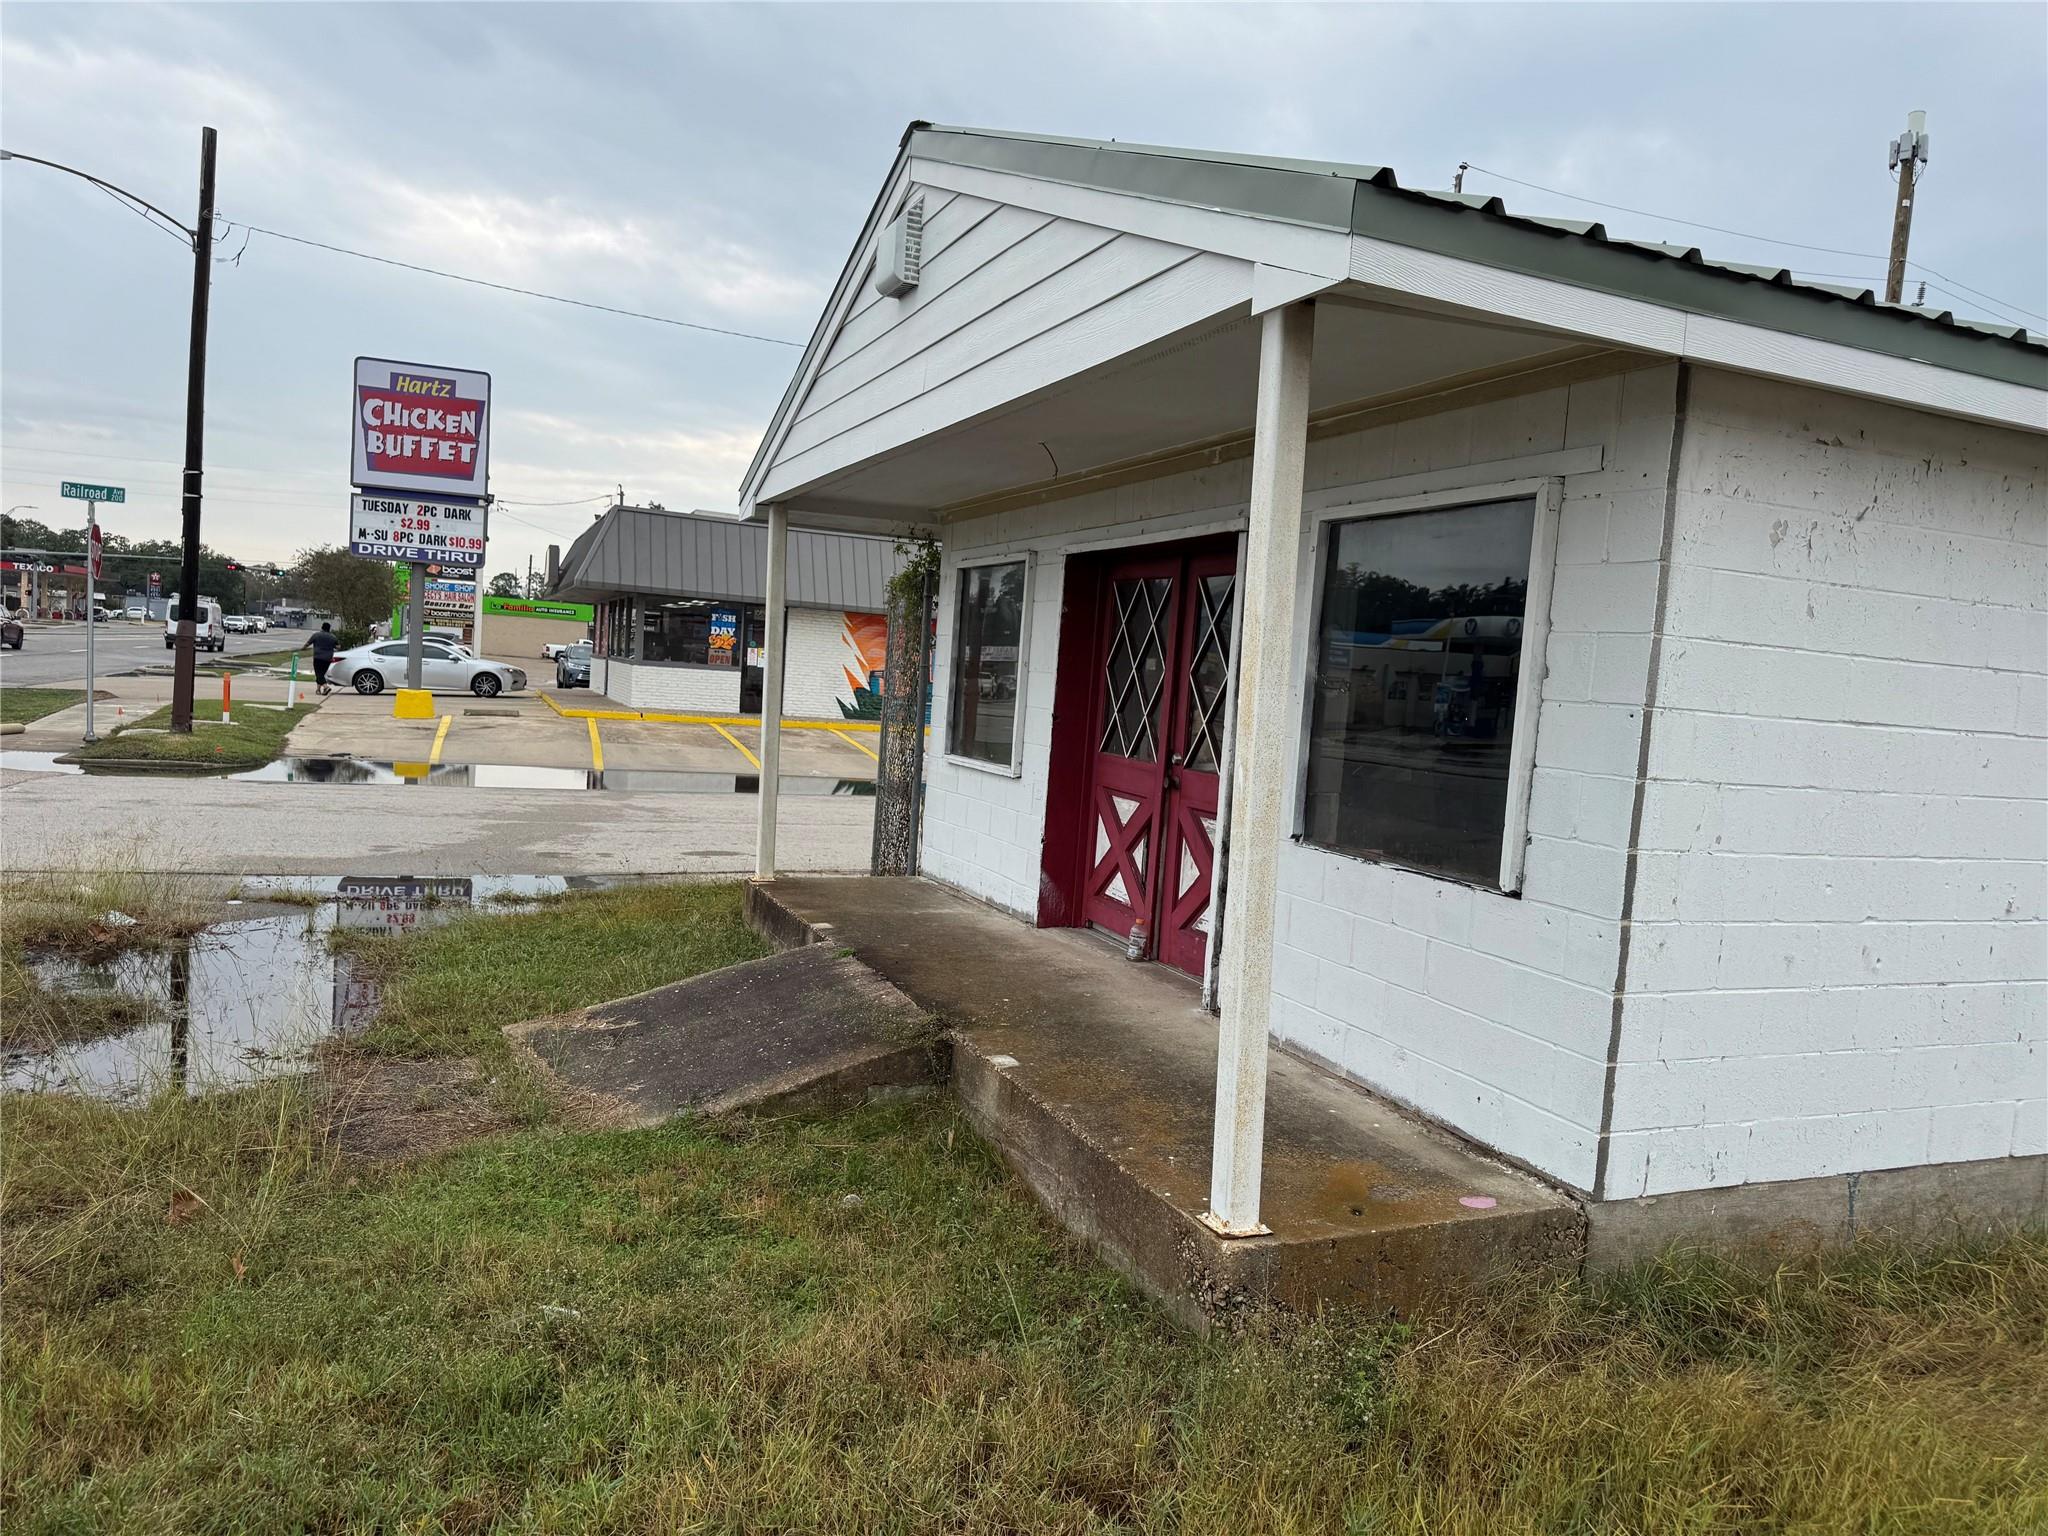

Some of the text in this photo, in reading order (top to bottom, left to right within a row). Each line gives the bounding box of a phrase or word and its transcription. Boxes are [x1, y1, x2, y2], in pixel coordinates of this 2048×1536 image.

[397, 376, 451, 398] Hartz
[362, 398, 476, 437] CHICKEN
[367, 430, 477, 464] BUFFET
[63, 484, 107, 500] Railroad
[111, 494, 123, 502] 200
[362, 499, 472, 521] TUESDAY 2PC DARK
[400, 518, 430, 531] $2.99
[393, 531, 414, 543] 8PC
[419, 533, 447, 547] DARK
[449, 536, 482, 550] $10.99
[358, 543, 478, 564] DRIVE THRU
[442, 565, 474, 576] boost
[424, 583, 474, 592] SMOKE SHOP
[710, 626, 736, 636] DAY
[709, 654, 731, 665] OPEN
